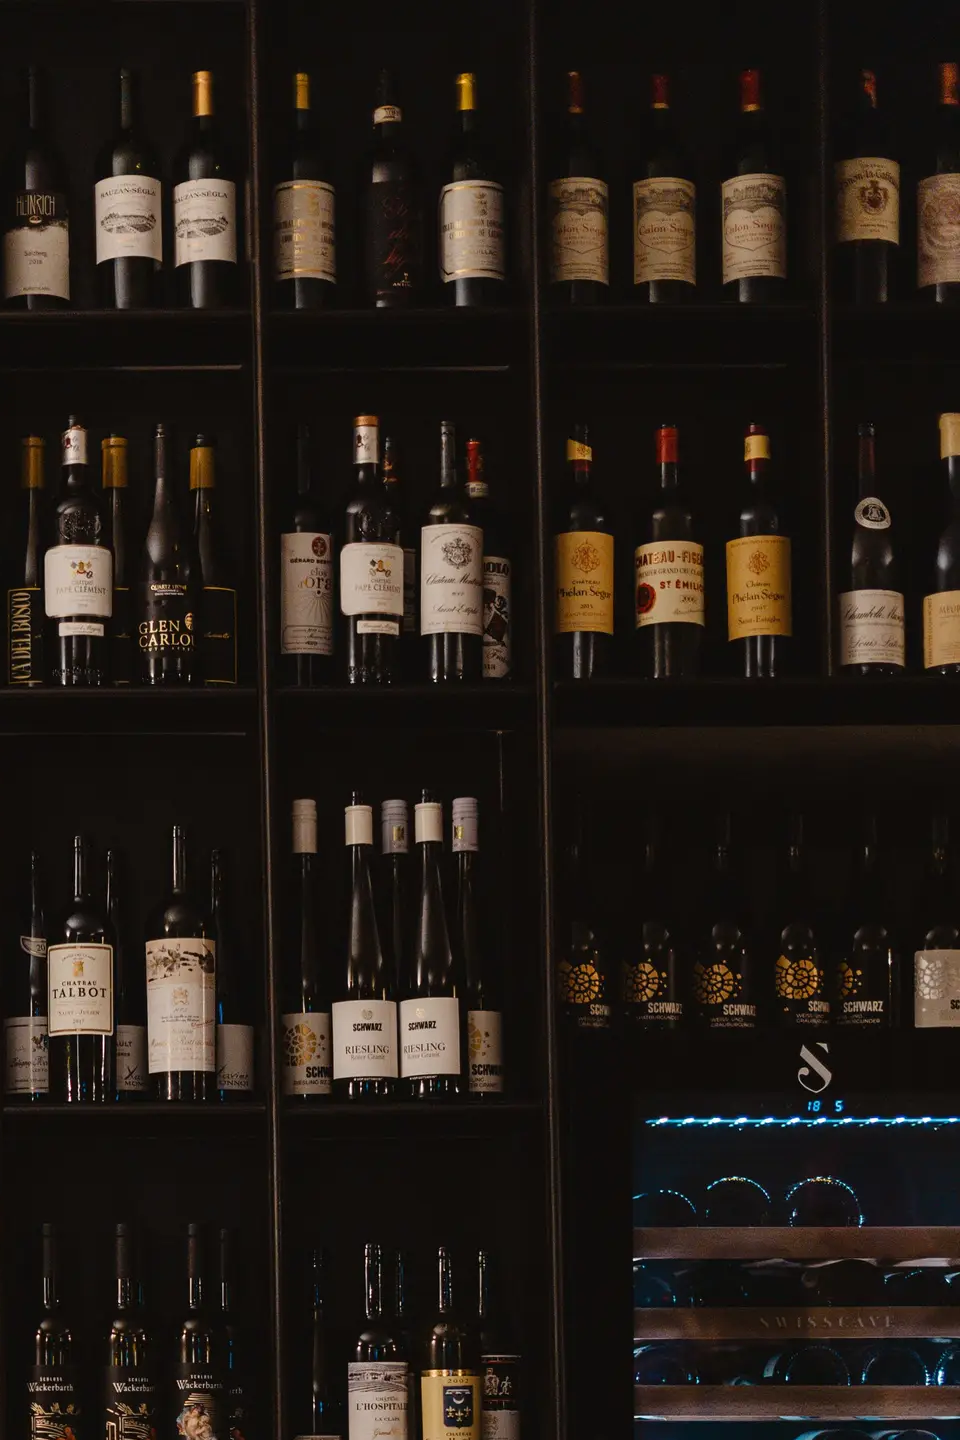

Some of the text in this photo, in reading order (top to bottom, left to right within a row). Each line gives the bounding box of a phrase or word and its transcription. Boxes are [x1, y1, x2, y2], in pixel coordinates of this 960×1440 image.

[100, 186, 157, 198] RAUZAN-SÉGLA
[16, 194, 55, 216] HEINRICH
[658, 569, 677, 577] GRAND
[426, 574, 457, 586] Château
[732, 593, 760, 605] Phélan
[138, 620, 180, 635] GLEN
[52, 988, 107, 999] TALBOT
[647, 1001, 683, 1015] SCHWARZ
[722, 1003, 756, 1017] SCHWARZ
[843, 1000, 884, 1014] SCHWARZ
[352, 1022, 382, 1032] SCHWARZ
[408, 1020, 437, 1031] SCHWARZ
[345, 1044, 390, 1055] RIESLING
[403, 1042, 447, 1055] RIESLING
[807, 1100, 845, 1113] 18 5
[759, 1314, 896, 1329] SWISSCAVE
[26, 1381, 74, 1393] Wackerbarth
